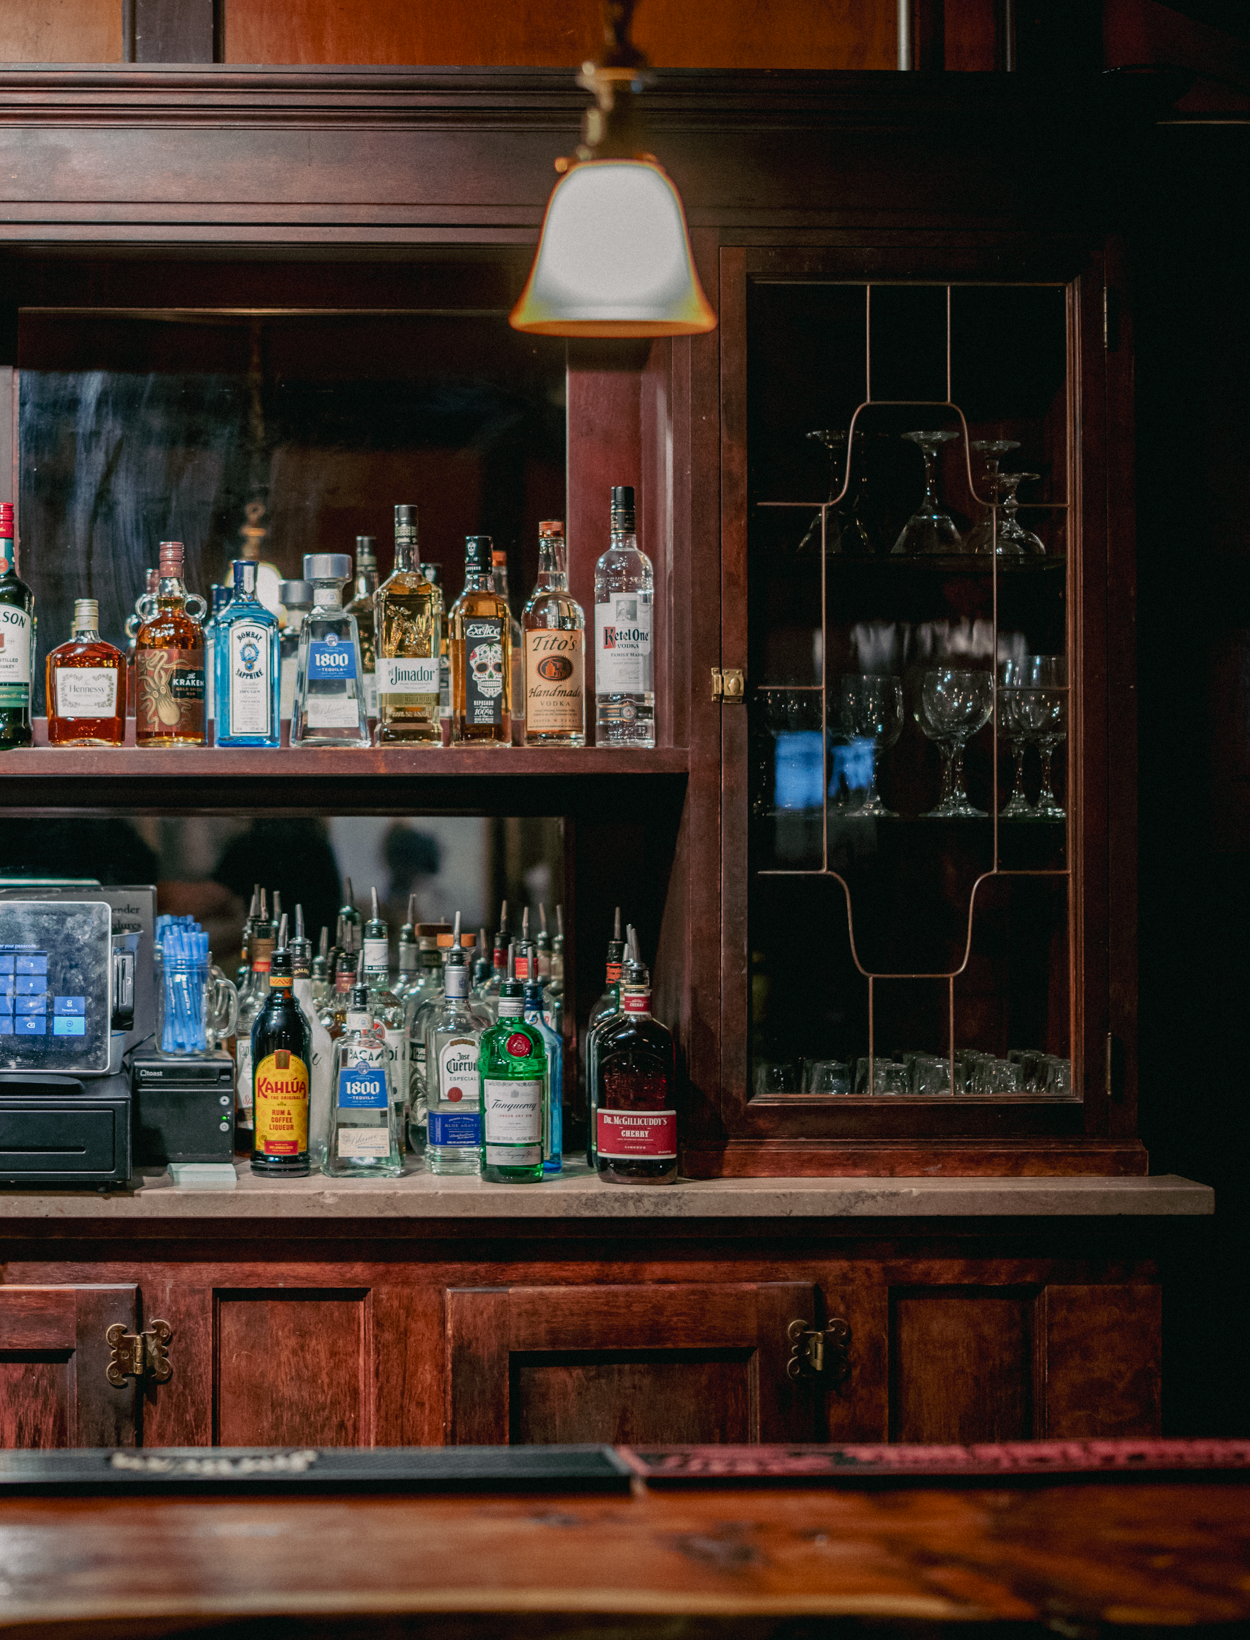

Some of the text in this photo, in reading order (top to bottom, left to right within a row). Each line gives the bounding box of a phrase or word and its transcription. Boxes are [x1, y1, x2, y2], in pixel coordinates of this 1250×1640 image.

[236, 631, 263, 643] BOMBAY
[532, 634, 578, 652] Tito's
[604, 628, 649, 647] Ketel One
[315, 653, 349, 667] 1800
[235, 668, 264, 680] SAPPHIRE
[390, 666, 435, 686] Jimador
[172, 678, 205, 687] KRAKEN
[69, 685, 105, 695] Hennessy
[257, 1077, 307, 1099] KAHLÚA
[345, 1081, 380, 1095] 1800
[491, 1099, 537, 1112] Tanqueray
[603, 1114, 613, 1125] DR.
[620, 1129, 650, 1138] CHERRY
